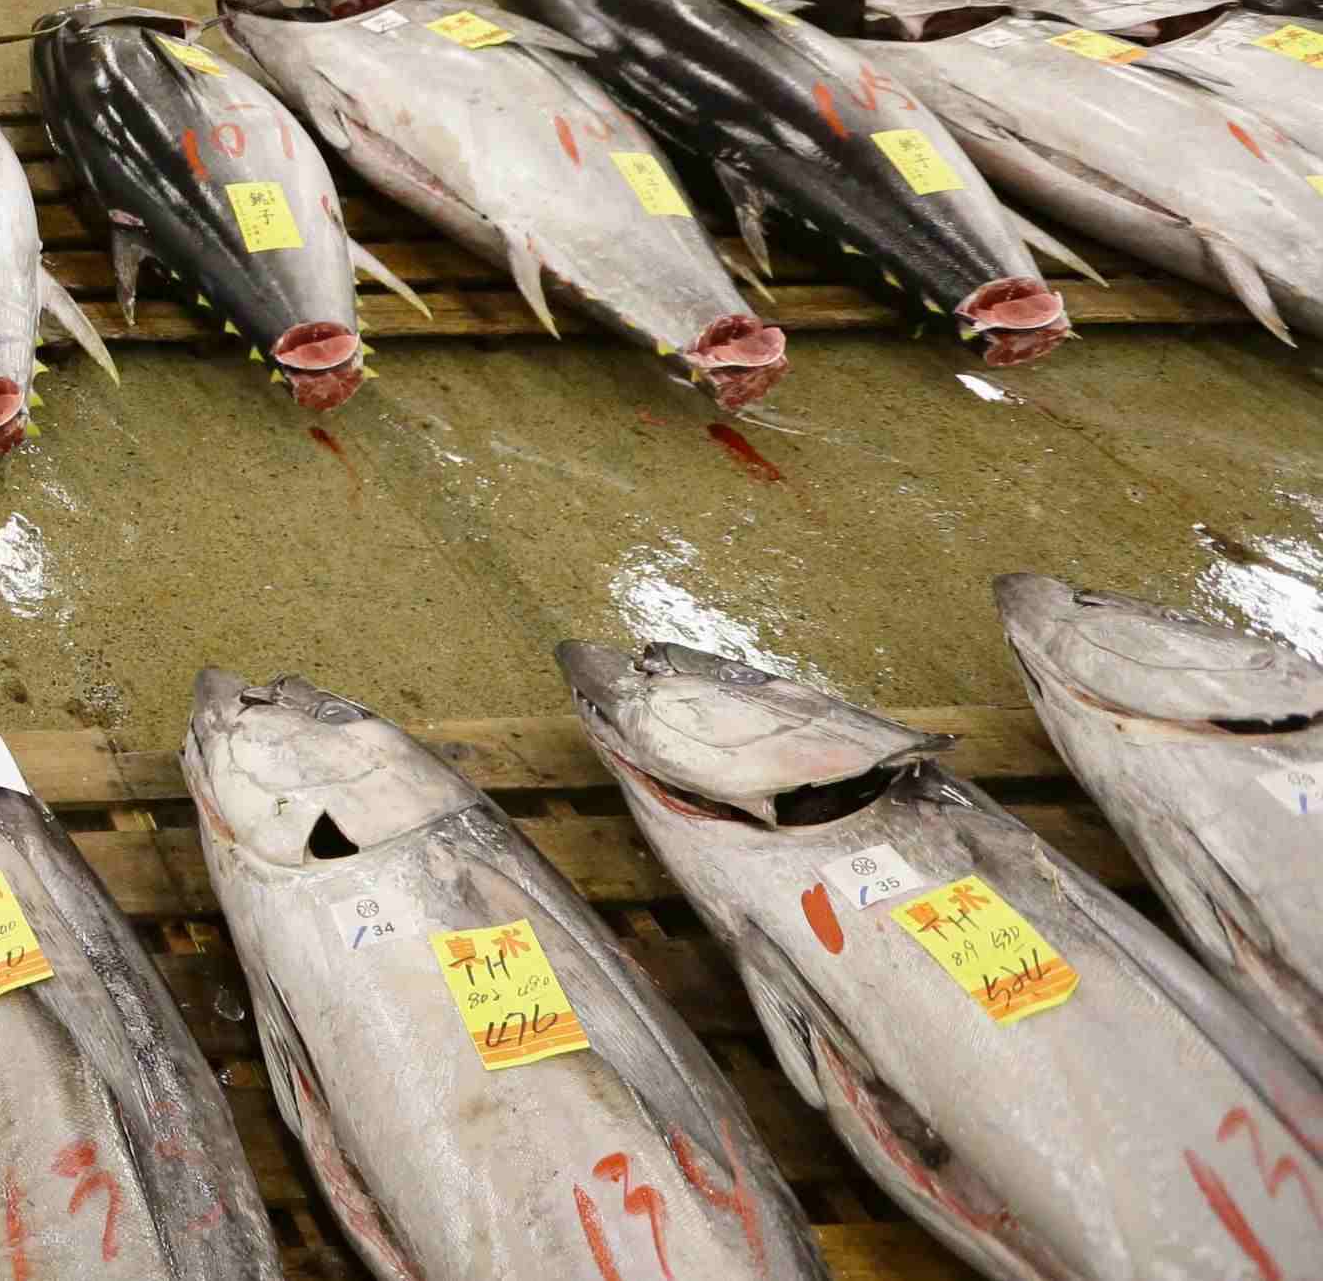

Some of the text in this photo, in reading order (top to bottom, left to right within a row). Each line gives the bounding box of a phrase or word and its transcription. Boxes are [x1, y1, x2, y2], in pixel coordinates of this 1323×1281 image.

[874, 876, 901, 893] 35
[372, 921, 396, 937] 34
[484, 1003, 559, 1049] 476
